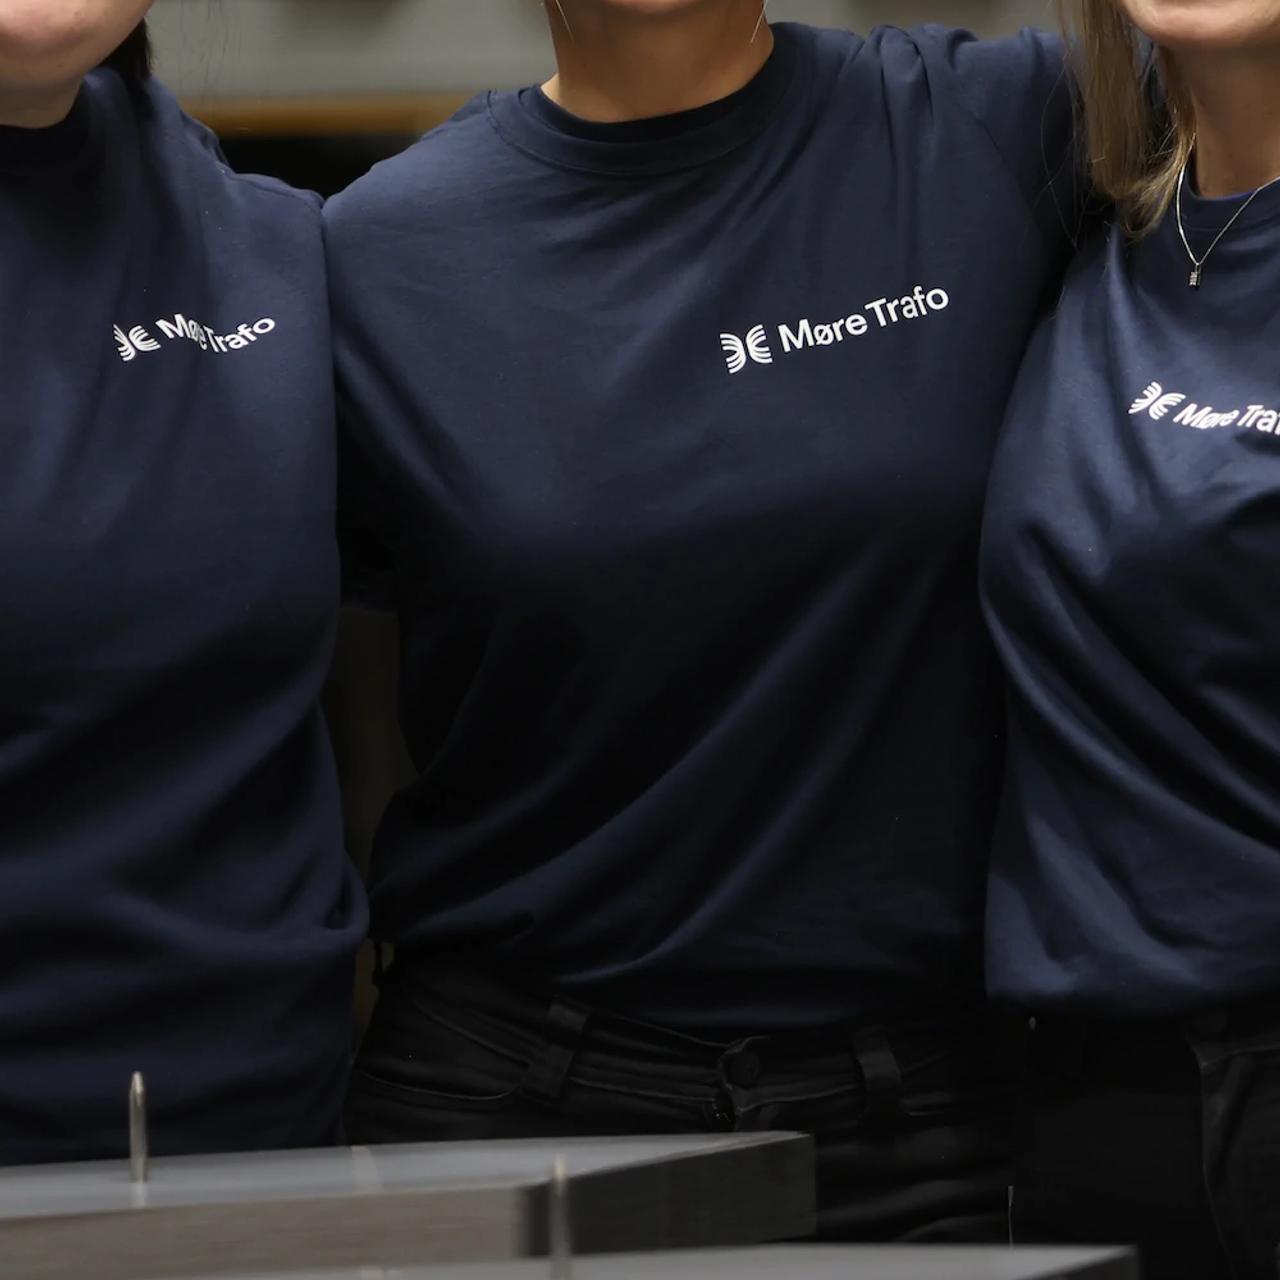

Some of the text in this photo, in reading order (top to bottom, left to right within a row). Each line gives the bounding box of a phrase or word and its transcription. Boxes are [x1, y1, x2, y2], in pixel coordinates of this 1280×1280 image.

[203, 317, 276, 353] Trafo
[777, 285, 949, 353] Møre Trafo
